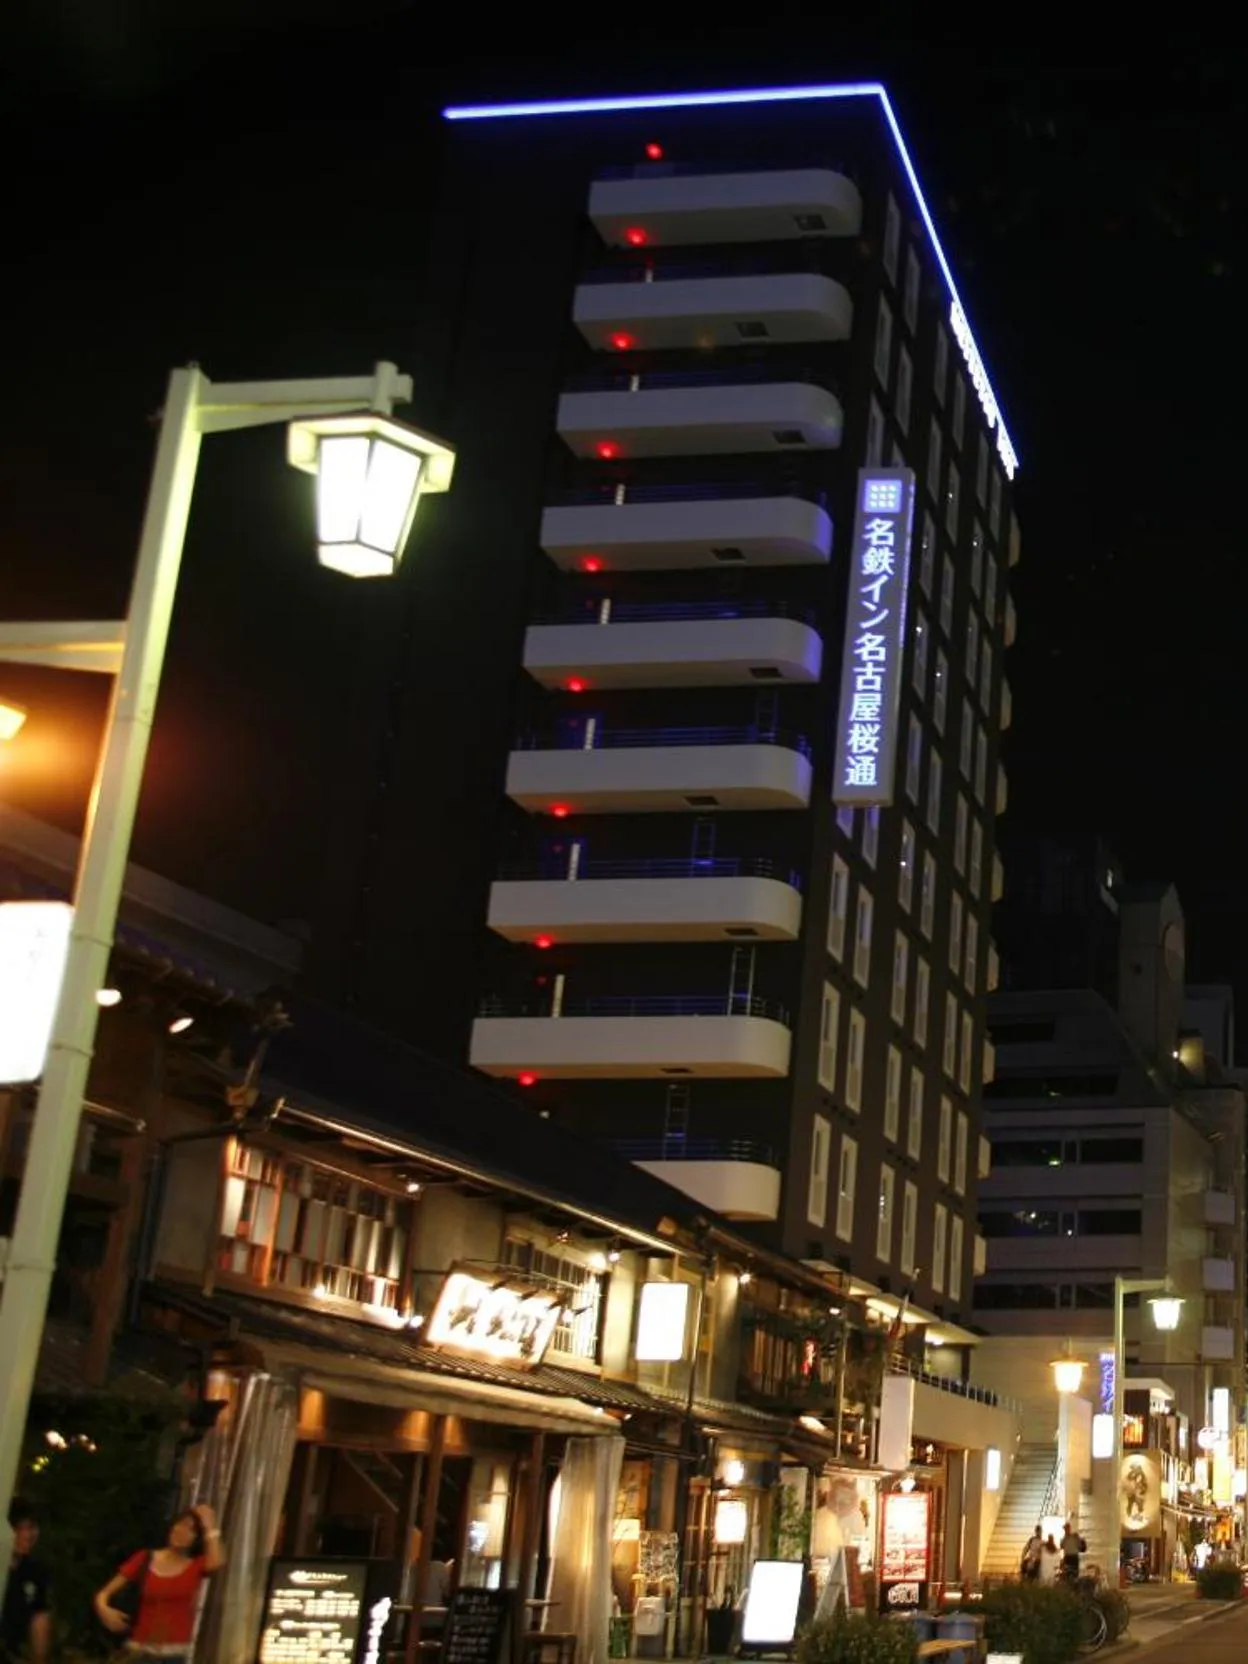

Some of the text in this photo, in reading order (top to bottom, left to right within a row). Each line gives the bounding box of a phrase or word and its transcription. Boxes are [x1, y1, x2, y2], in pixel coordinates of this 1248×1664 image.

[845, 518, 895, 786] 名鉄イン名古屋桜通
